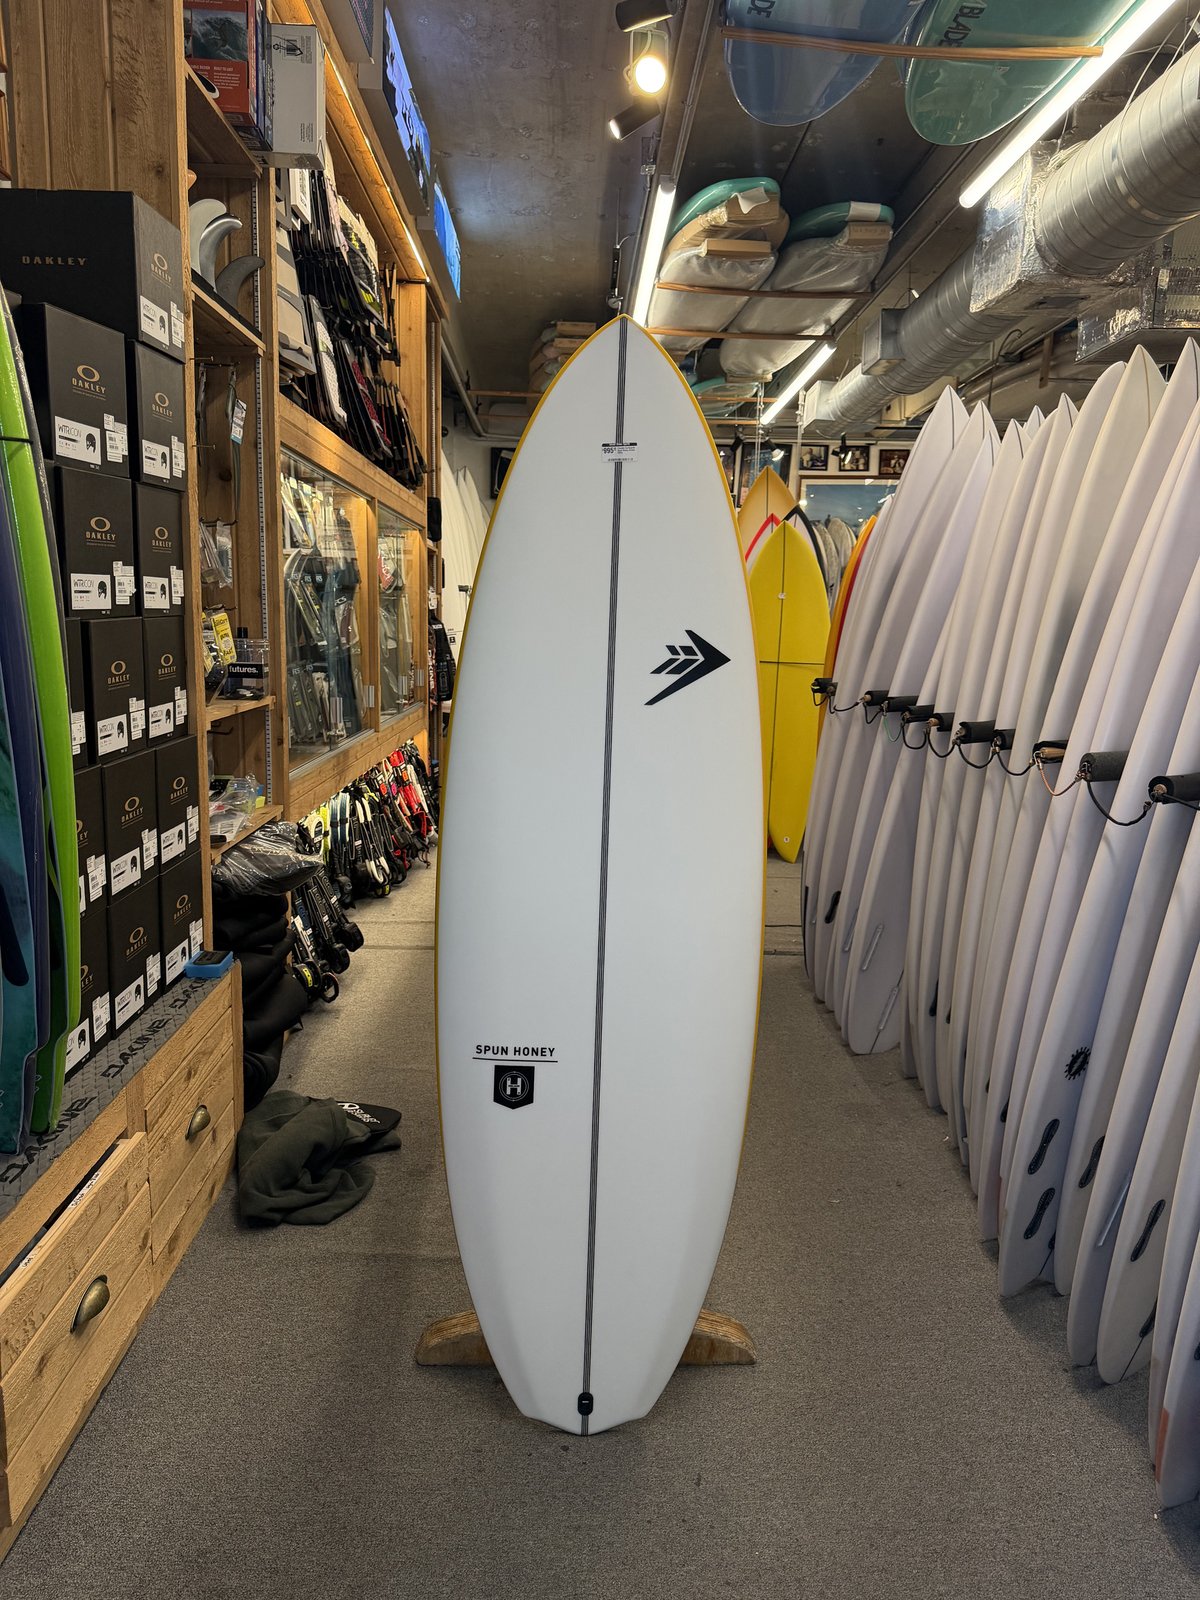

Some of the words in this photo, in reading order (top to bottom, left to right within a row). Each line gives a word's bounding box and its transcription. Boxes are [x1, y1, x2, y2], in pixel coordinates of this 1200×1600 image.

[22, 256, 87, 266] OAKLEY
[72, 377, 106, 394] OAKLEY
[152, 404, 173, 417] OAKLEY
[86, 531, 116, 541] OAKLEY
[152, 540, 172, 548] OAKLEY
[158, 666, 176, 675] OAKLEY
[229, 665, 259, 673] futures.
[108, 674, 130, 685] OAKLEY
[170, 787, 189, 800] OAKLEY
[121, 807, 144, 823] OAKLEY
[173, 902, 192, 919] OAKLEY
[126, 935, 148, 956] OAKLEY
[475, 1044, 509, 1056] SPUN
[513, 1046, 556, 1057] HONEY
